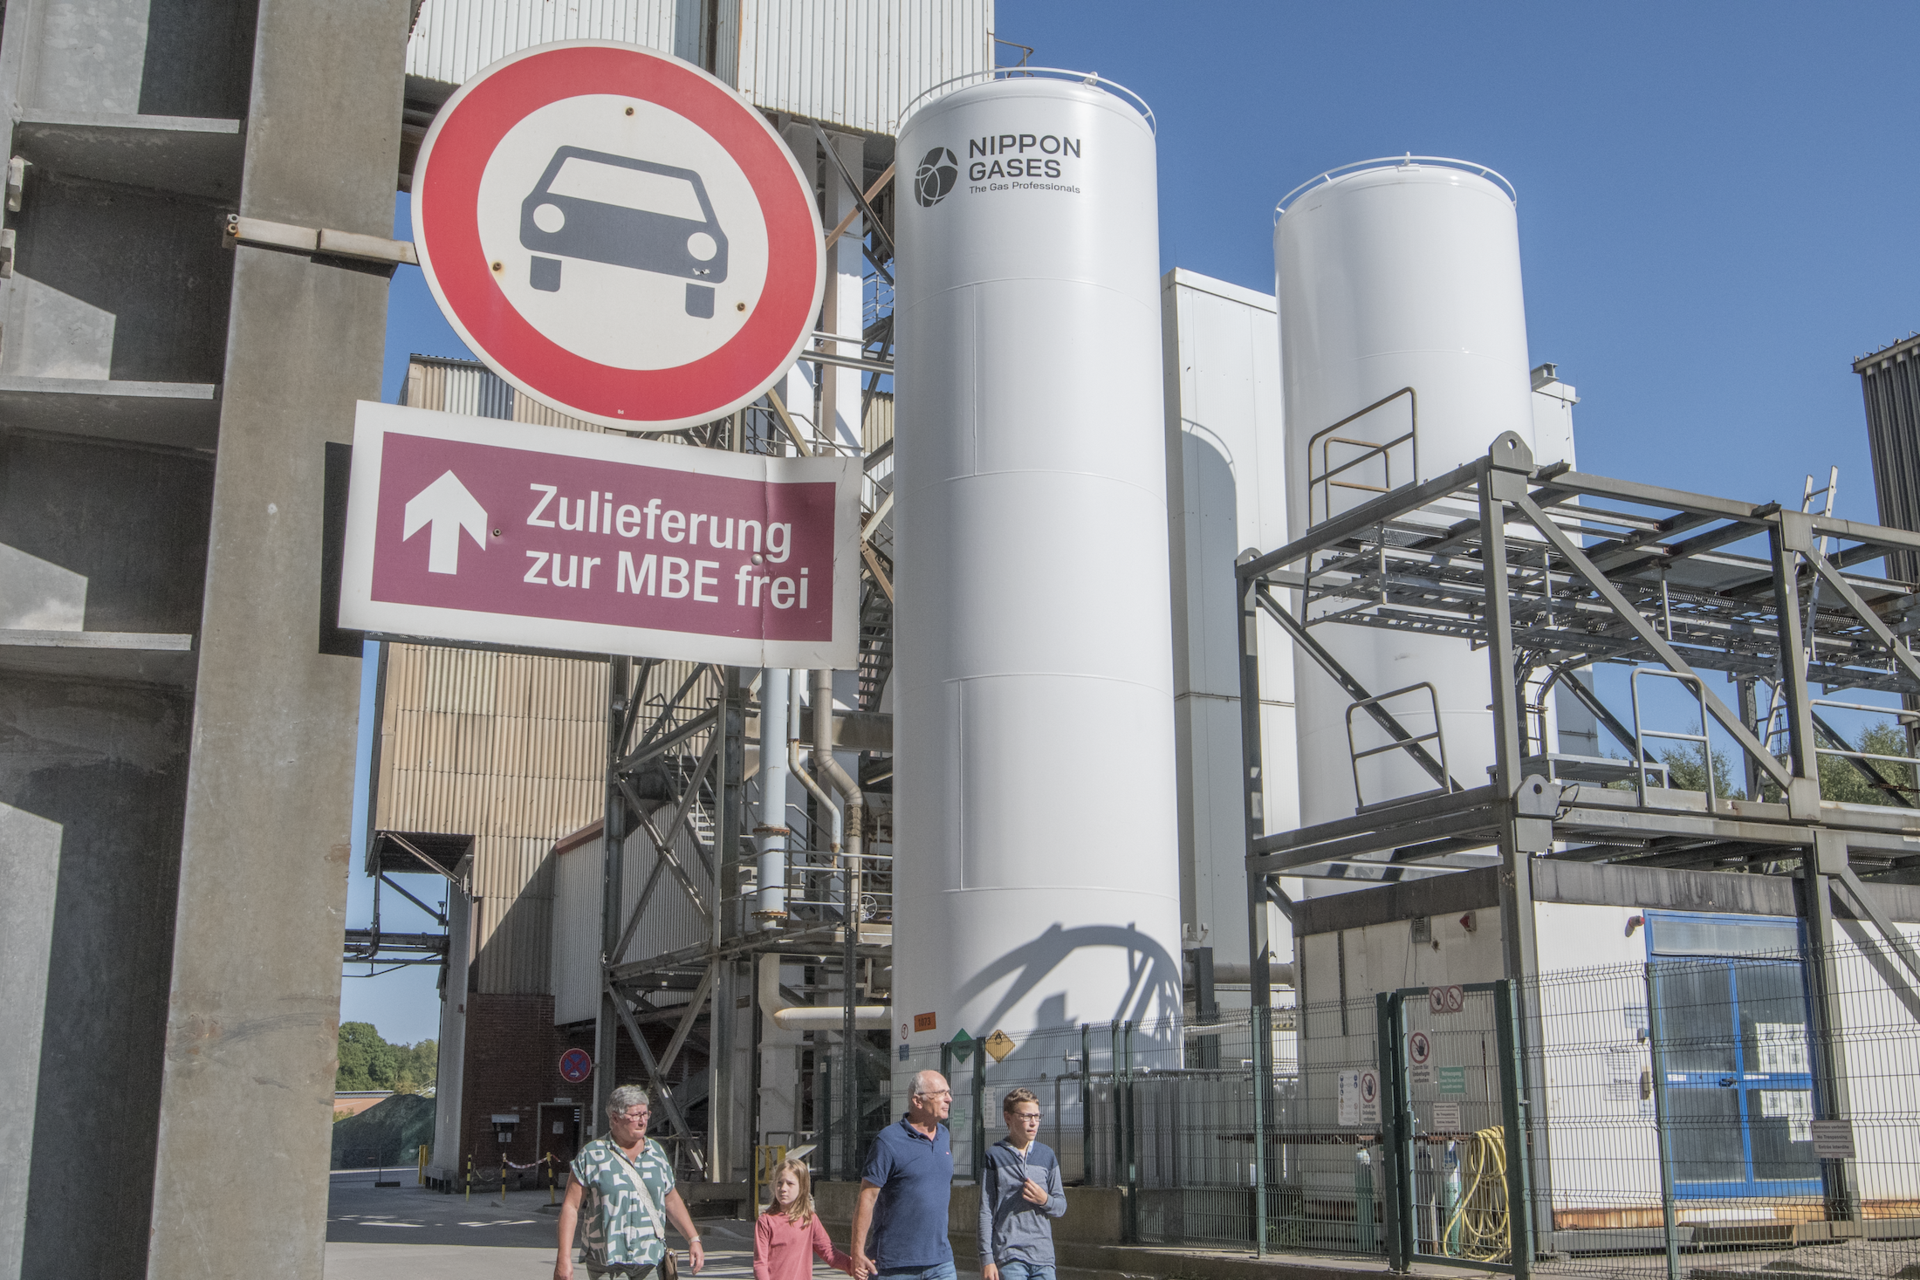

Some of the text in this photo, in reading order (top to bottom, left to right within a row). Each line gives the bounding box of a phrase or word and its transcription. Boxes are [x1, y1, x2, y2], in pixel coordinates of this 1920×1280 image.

[969, 134, 1081, 159] NIPPON
[969, 158, 1061, 182] GASES
[969, 181, 1081, 195] The Gas Professionals
[526, 483, 792, 564] Zulieferung
[523, 550, 809, 609] zur MBE frei
